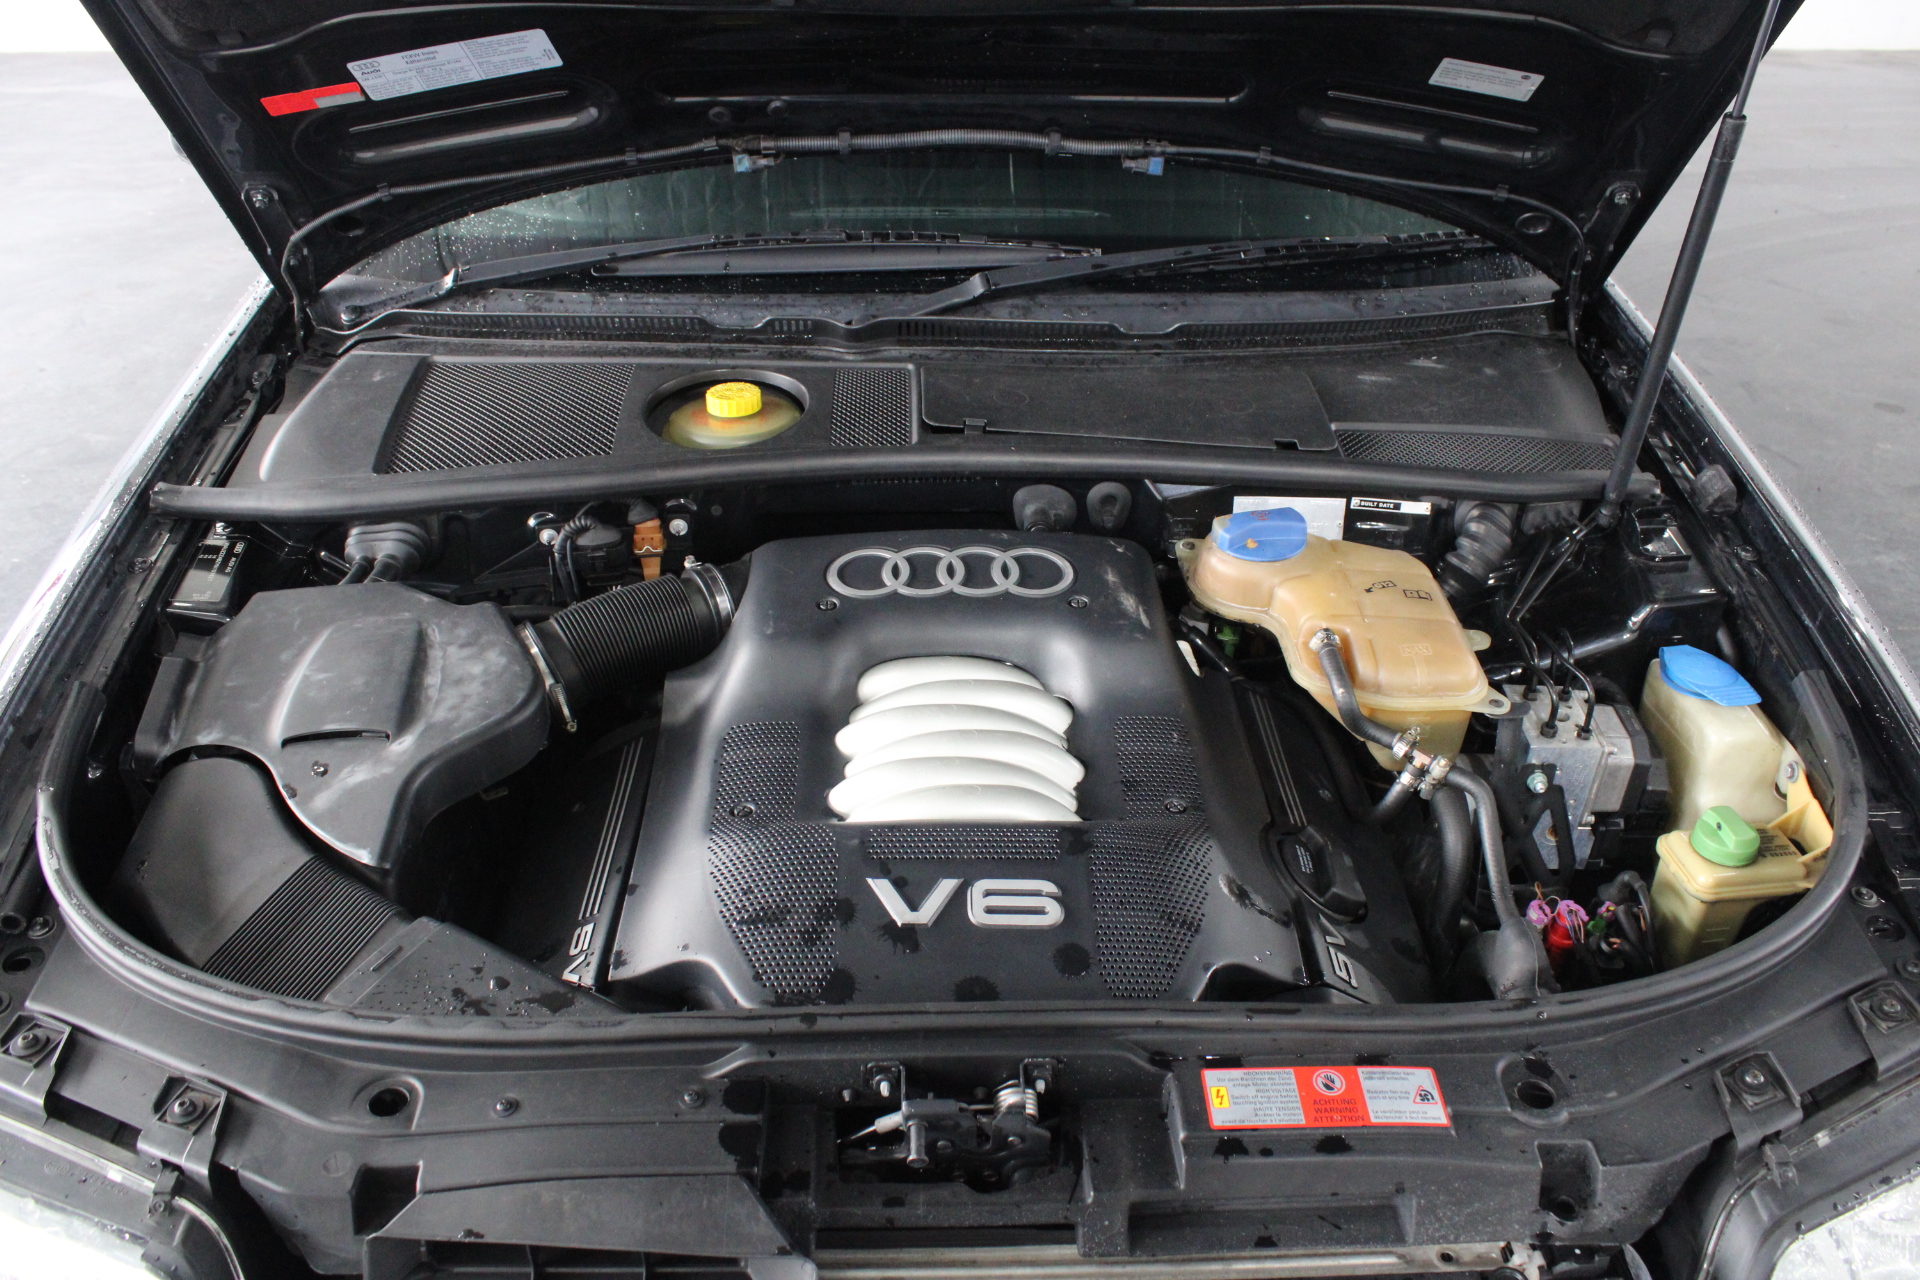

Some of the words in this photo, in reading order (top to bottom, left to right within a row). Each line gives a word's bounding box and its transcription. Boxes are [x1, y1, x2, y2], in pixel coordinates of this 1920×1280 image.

[228, 557, 237, 567] AUDI
[866, 877, 1065, 929] V6
[1313, 1098, 1357, 1106] ACHTUNG
[1313, 1106, 1359, 1114] WARNING
[1313, 1115, 1365, 1123] ATTENTION
